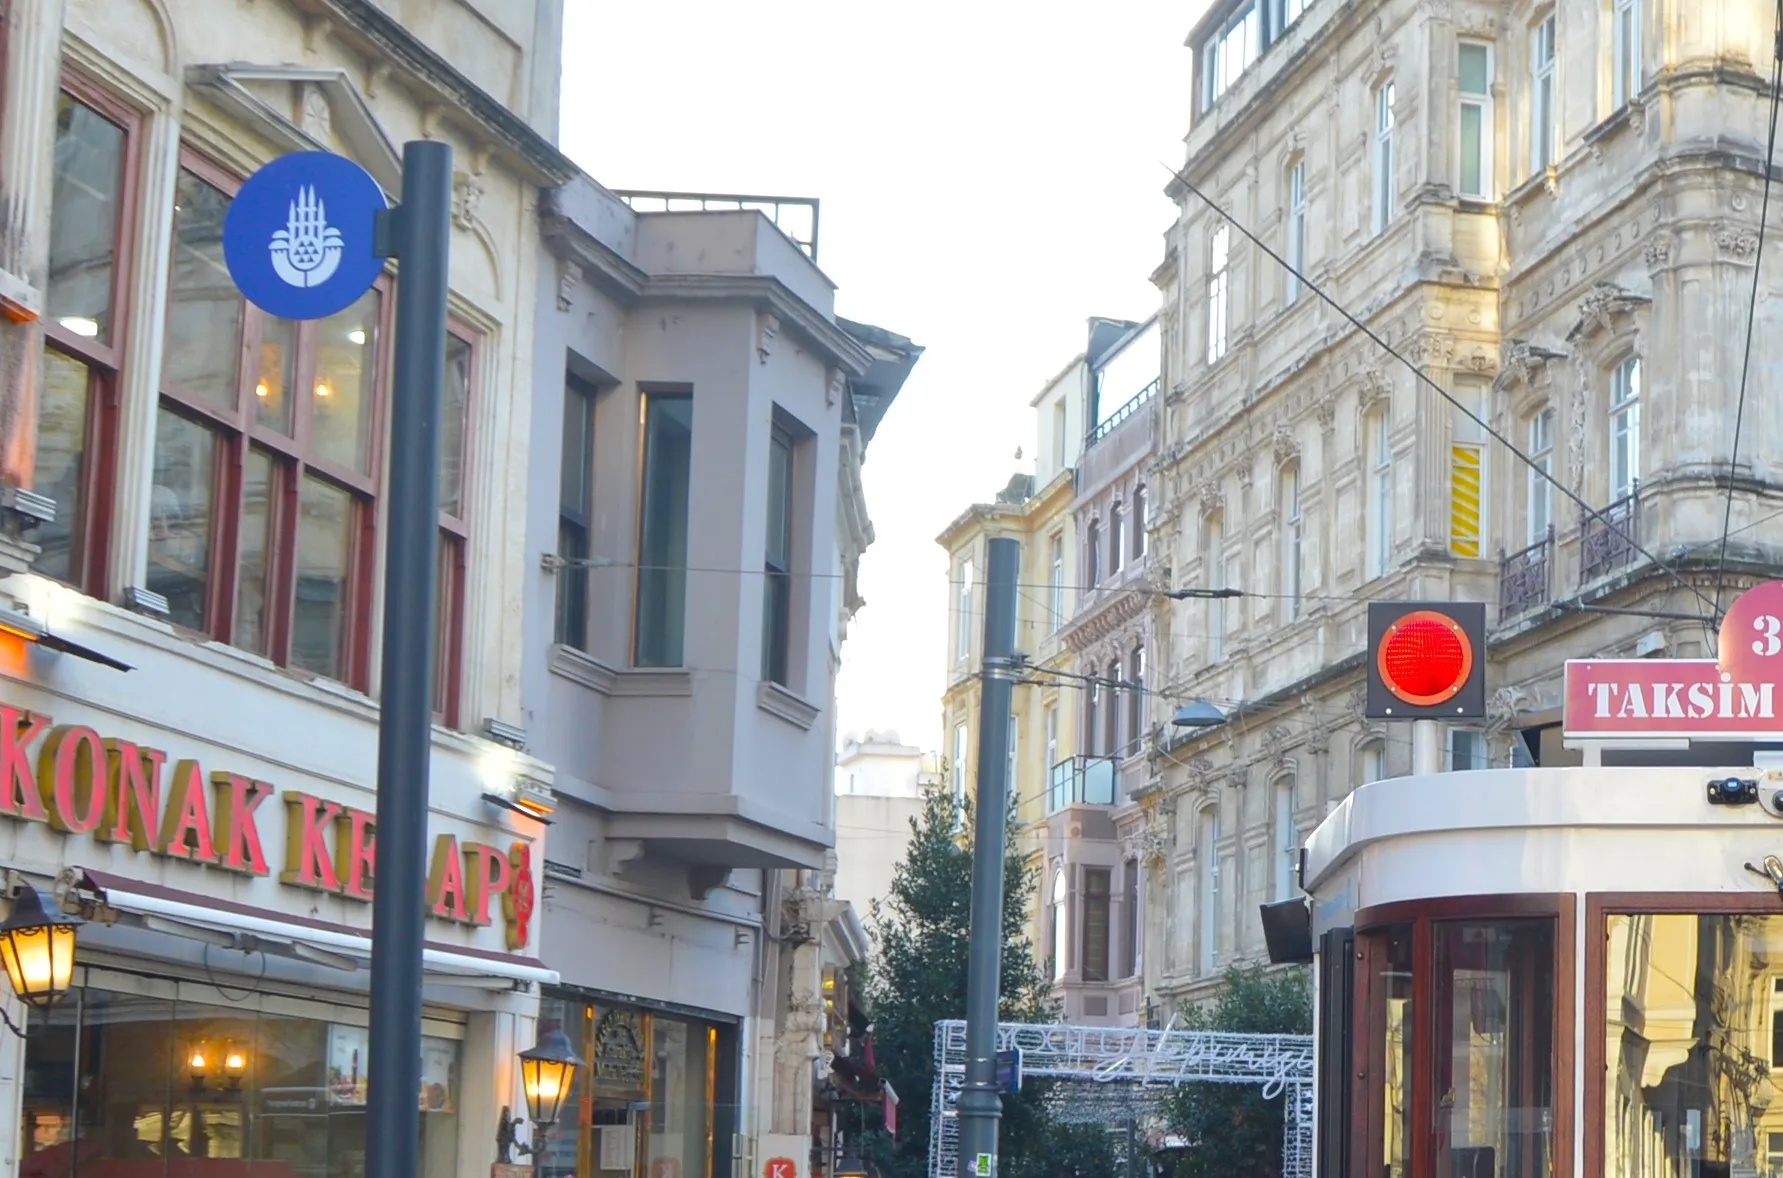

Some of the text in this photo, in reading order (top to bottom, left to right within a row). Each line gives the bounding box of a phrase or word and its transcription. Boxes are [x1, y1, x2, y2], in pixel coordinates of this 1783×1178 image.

[1588, 672, 1775, 719] TAKSİM
[0, 705, 512, 927] KONAK KEAP
